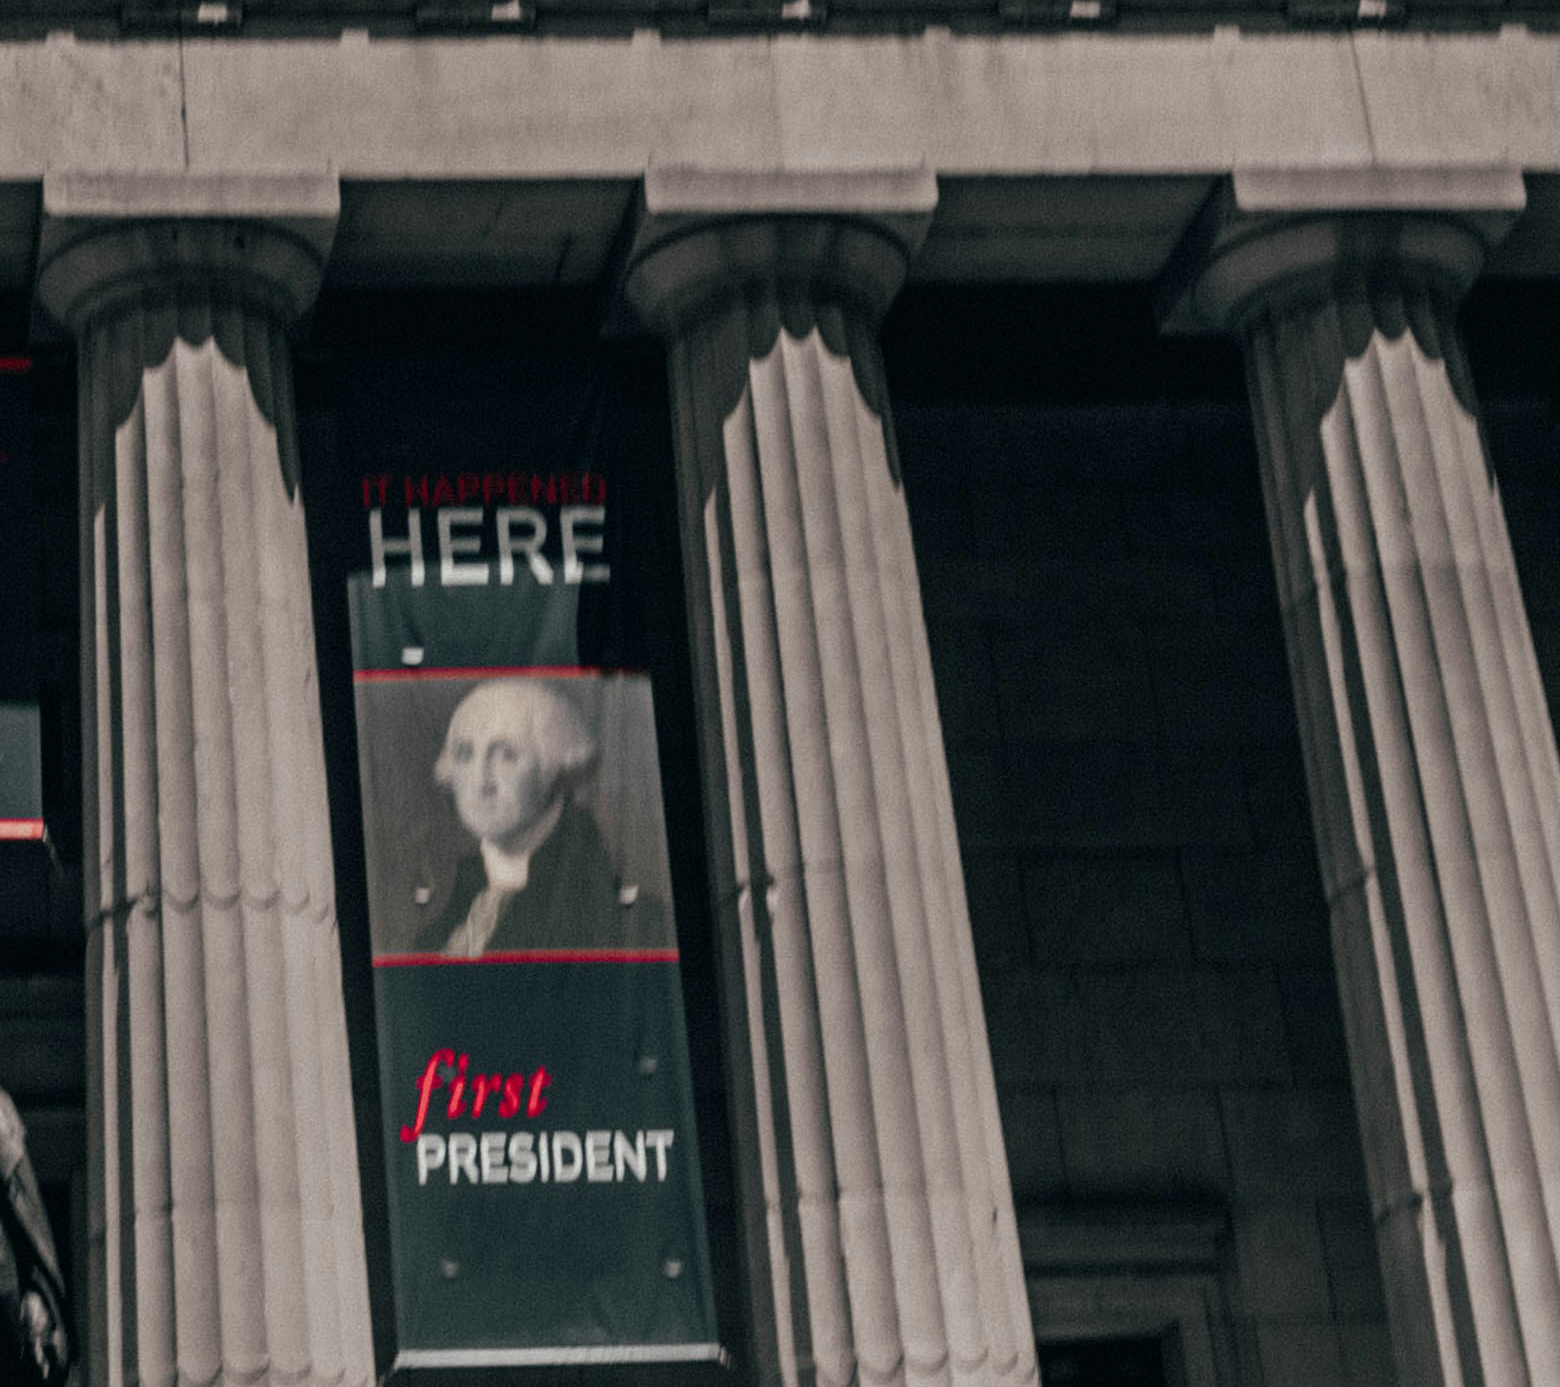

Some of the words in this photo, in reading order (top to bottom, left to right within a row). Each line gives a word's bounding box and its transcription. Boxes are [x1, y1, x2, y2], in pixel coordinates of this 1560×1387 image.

[363, 473, 391, 508] IT
[404, 471, 606, 507] HAPPENED
[369, 505, 611, 588] HERE
[400, 1048, 551, 1143] first
[416, 1129, 674, 1187] PRESIDENT
